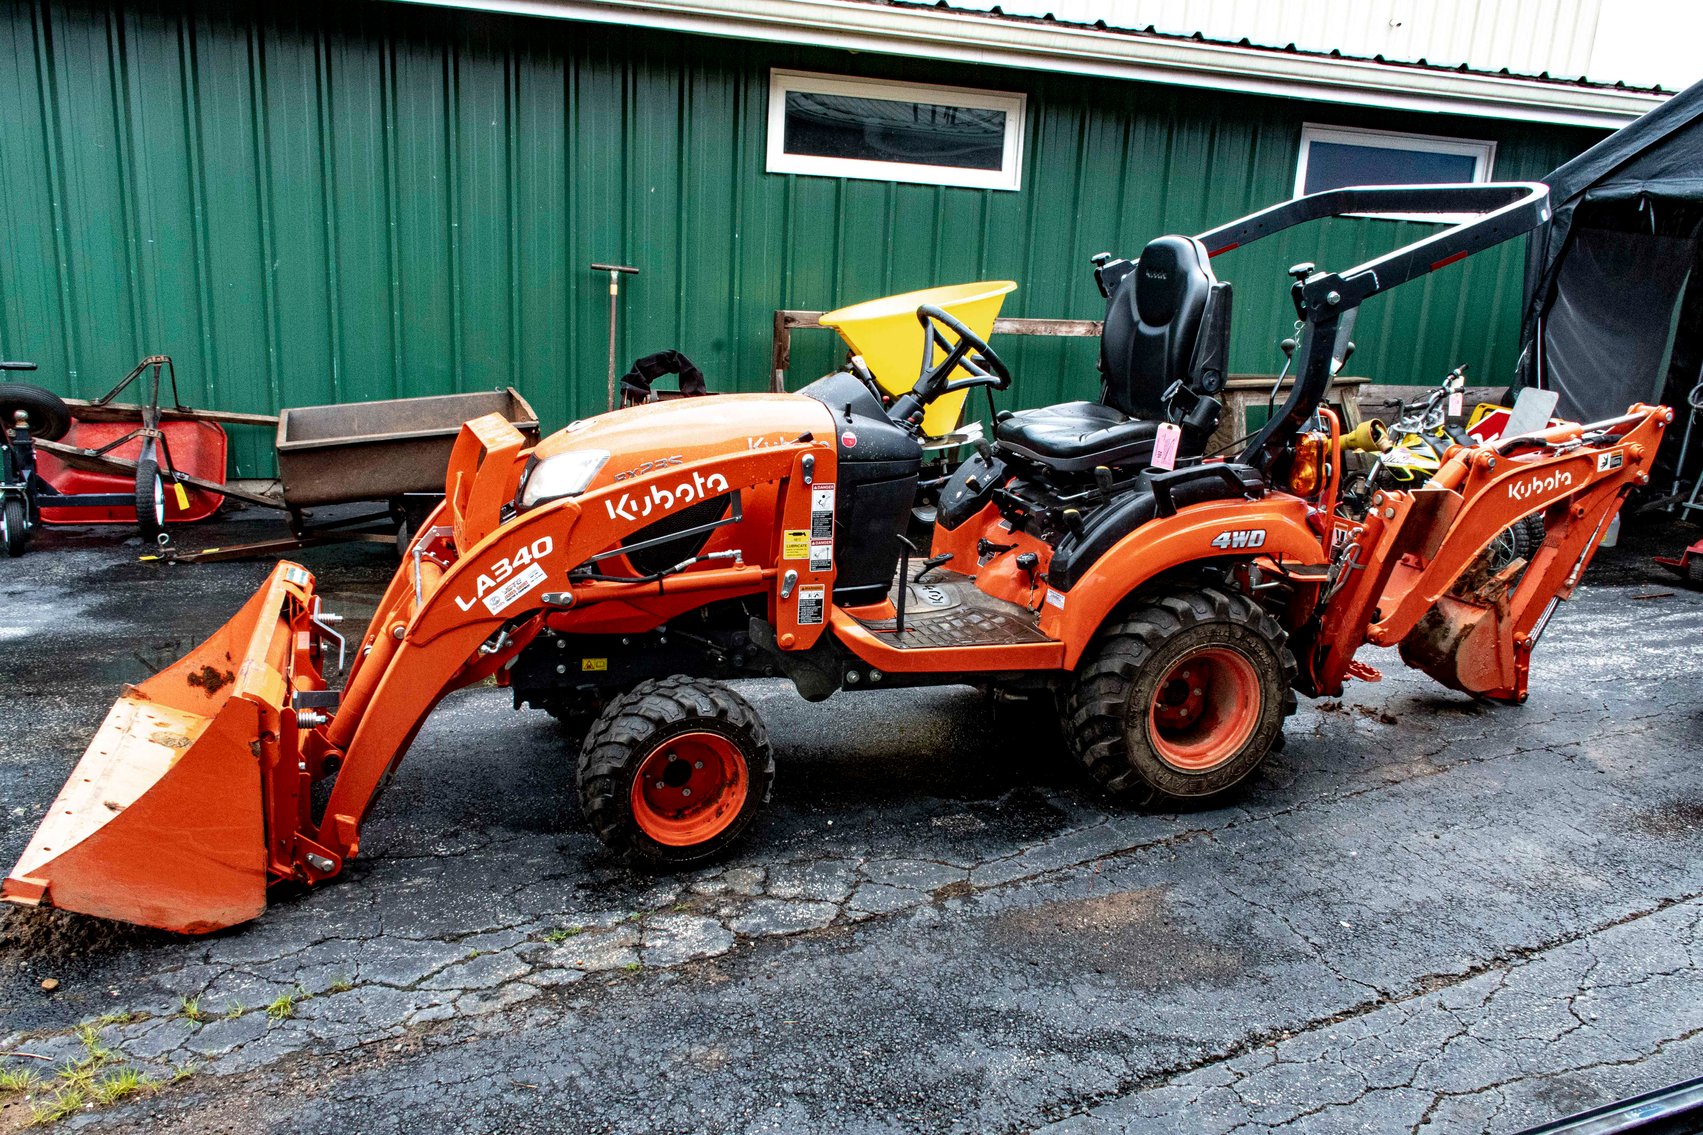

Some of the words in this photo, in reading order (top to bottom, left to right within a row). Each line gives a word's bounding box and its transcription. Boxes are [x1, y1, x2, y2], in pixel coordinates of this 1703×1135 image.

[604, 471, 730, 521] Kubota
[1508, 469, 1572, 500] Kubota
[1211, 530, 1266, 549] 4WD
[454, 536, 553, 612] LA340
